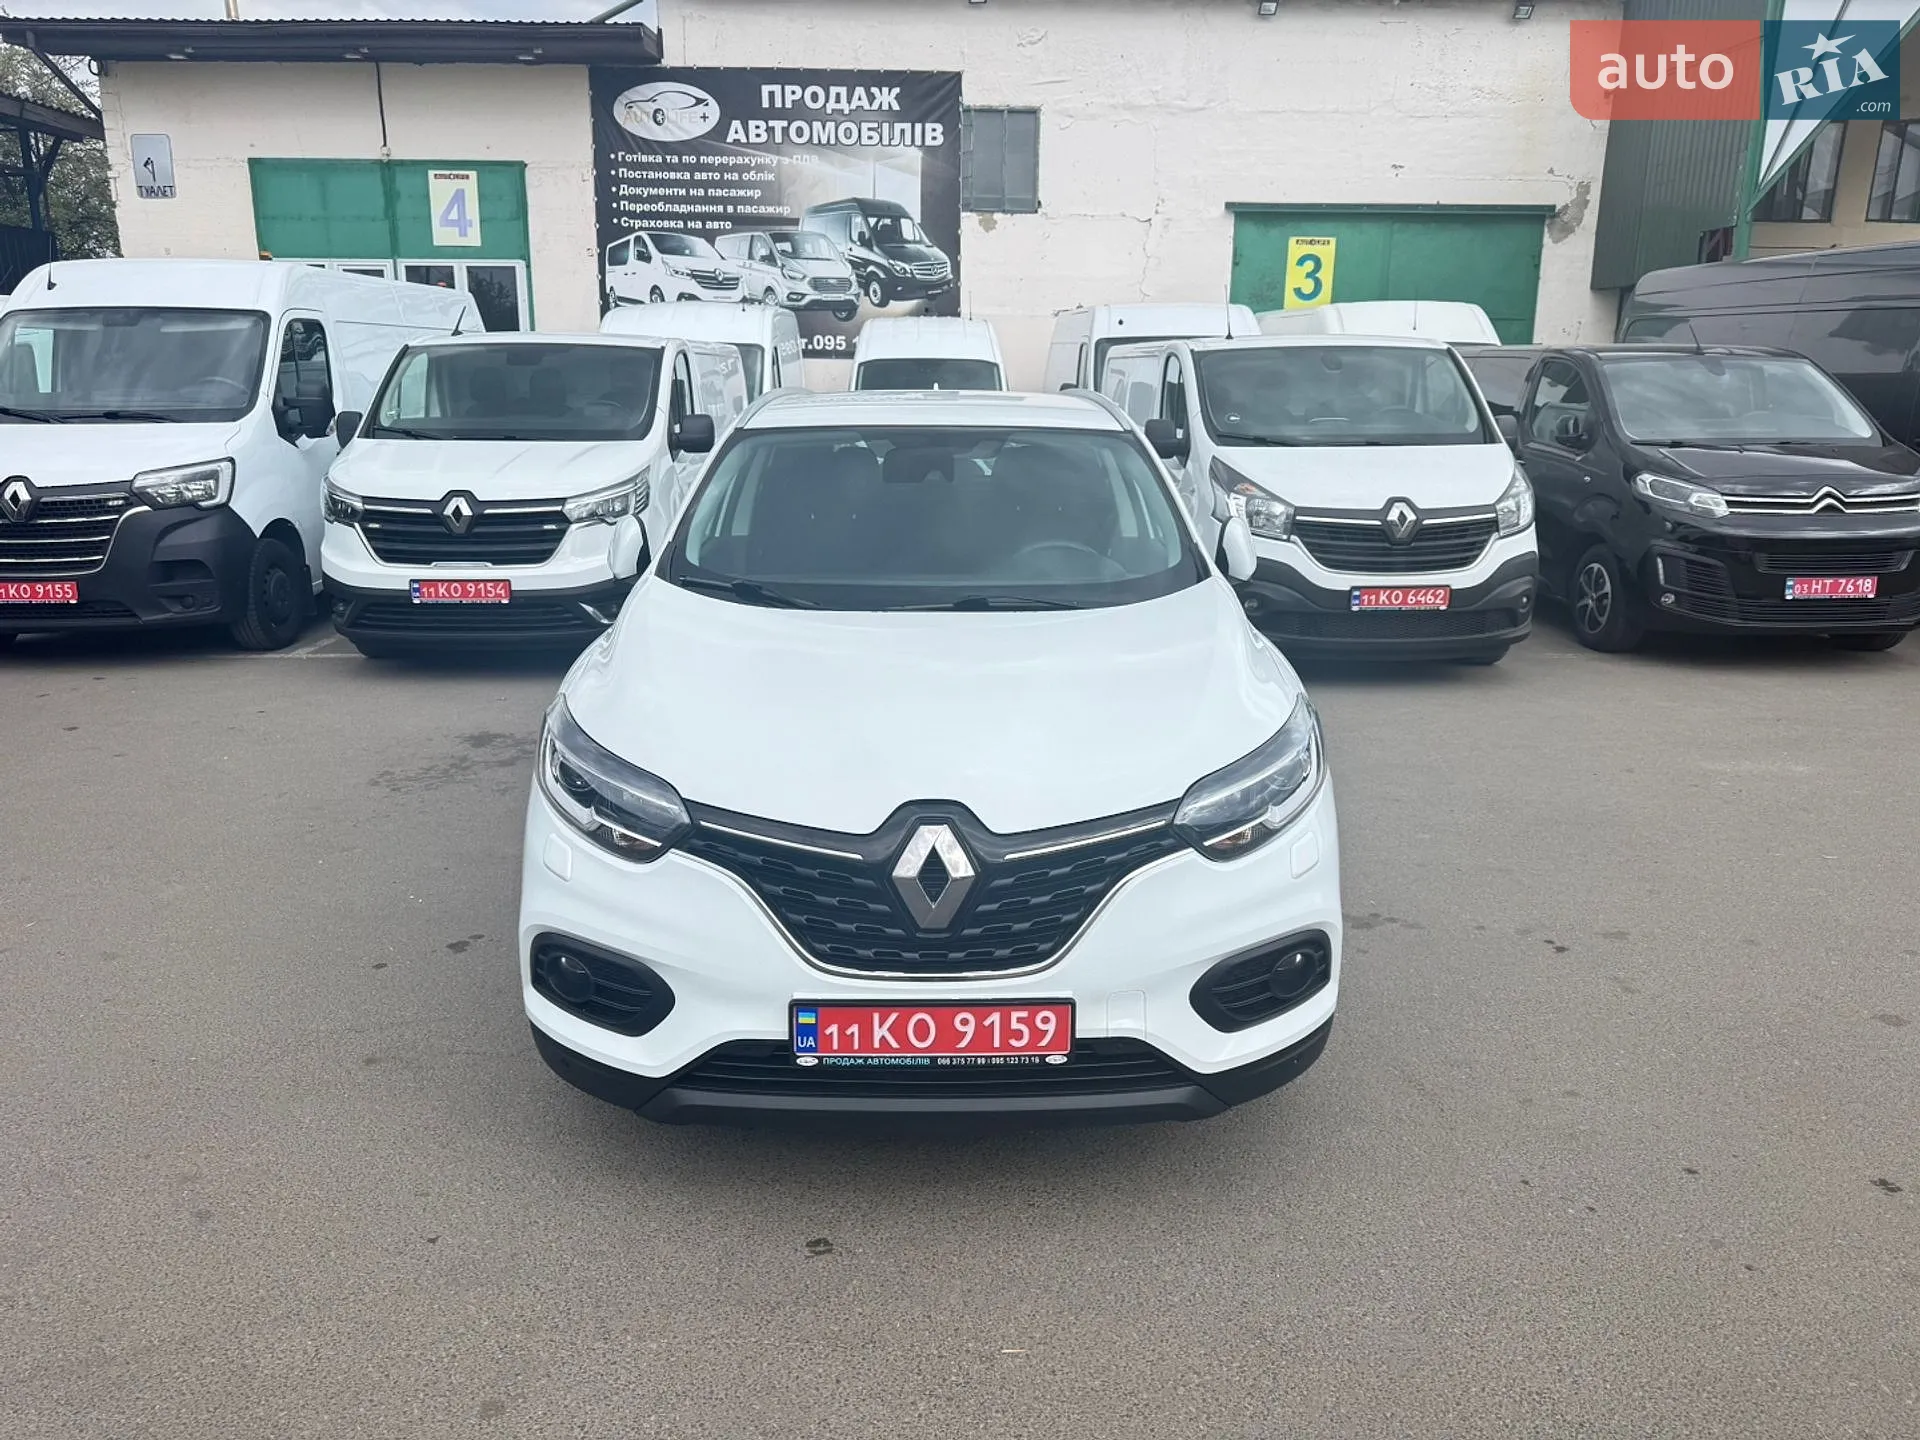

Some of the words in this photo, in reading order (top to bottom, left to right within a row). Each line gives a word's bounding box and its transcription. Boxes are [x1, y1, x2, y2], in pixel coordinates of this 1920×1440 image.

[761, 84, 901, 114] ПРОДАЖ
[726, 120, 944, 147] АВТОМОБІЛІВ
[618, 152, 661, 164] Готівка
[665, 155, 679, 164] та
[682, 155, 697, 164] по
[700, 155, 778, 168] перерахунку
[618, 168, 690, 180] Постановка
[694, 171, 720, 180] авто
[724, 171, 738, 180] на
[742, 169, 775, 181] облік
[136, 185, 174, 197] ТУАЛЕТ
[618, 185, 686, 197] Документи
[689, 187, 704, 196] на
[708, 188, 762, 199] пасажир
[439, 188, 473, 237] 4
[620, 201, 724, 214] Переобладнання
[727, 205, 734, 213] в
[737, 205, 791, 216] пасажир
[621, 217, 683, 230] Страховка
[687, 219, 702, 229] на
[706, 220, 732, 230] авто
[1293, 253, 1323, 301] 3
[35, 584, 73, 598] 9155
[466, 583, 506, 597] 9154
[1838, 578, 1872, 593] 7618
[1407, 589, 1445, 604] 6462
[824, 1023, 860, 1050] 11
[953, 1010, 1057, 1048] 9159
[798, 1036, 816, 1048] UA
[822, 1057, 865, 1066] ПРОДАЖ
[866, 1057, 931, 1066] АВТОМОБІЛІВ
